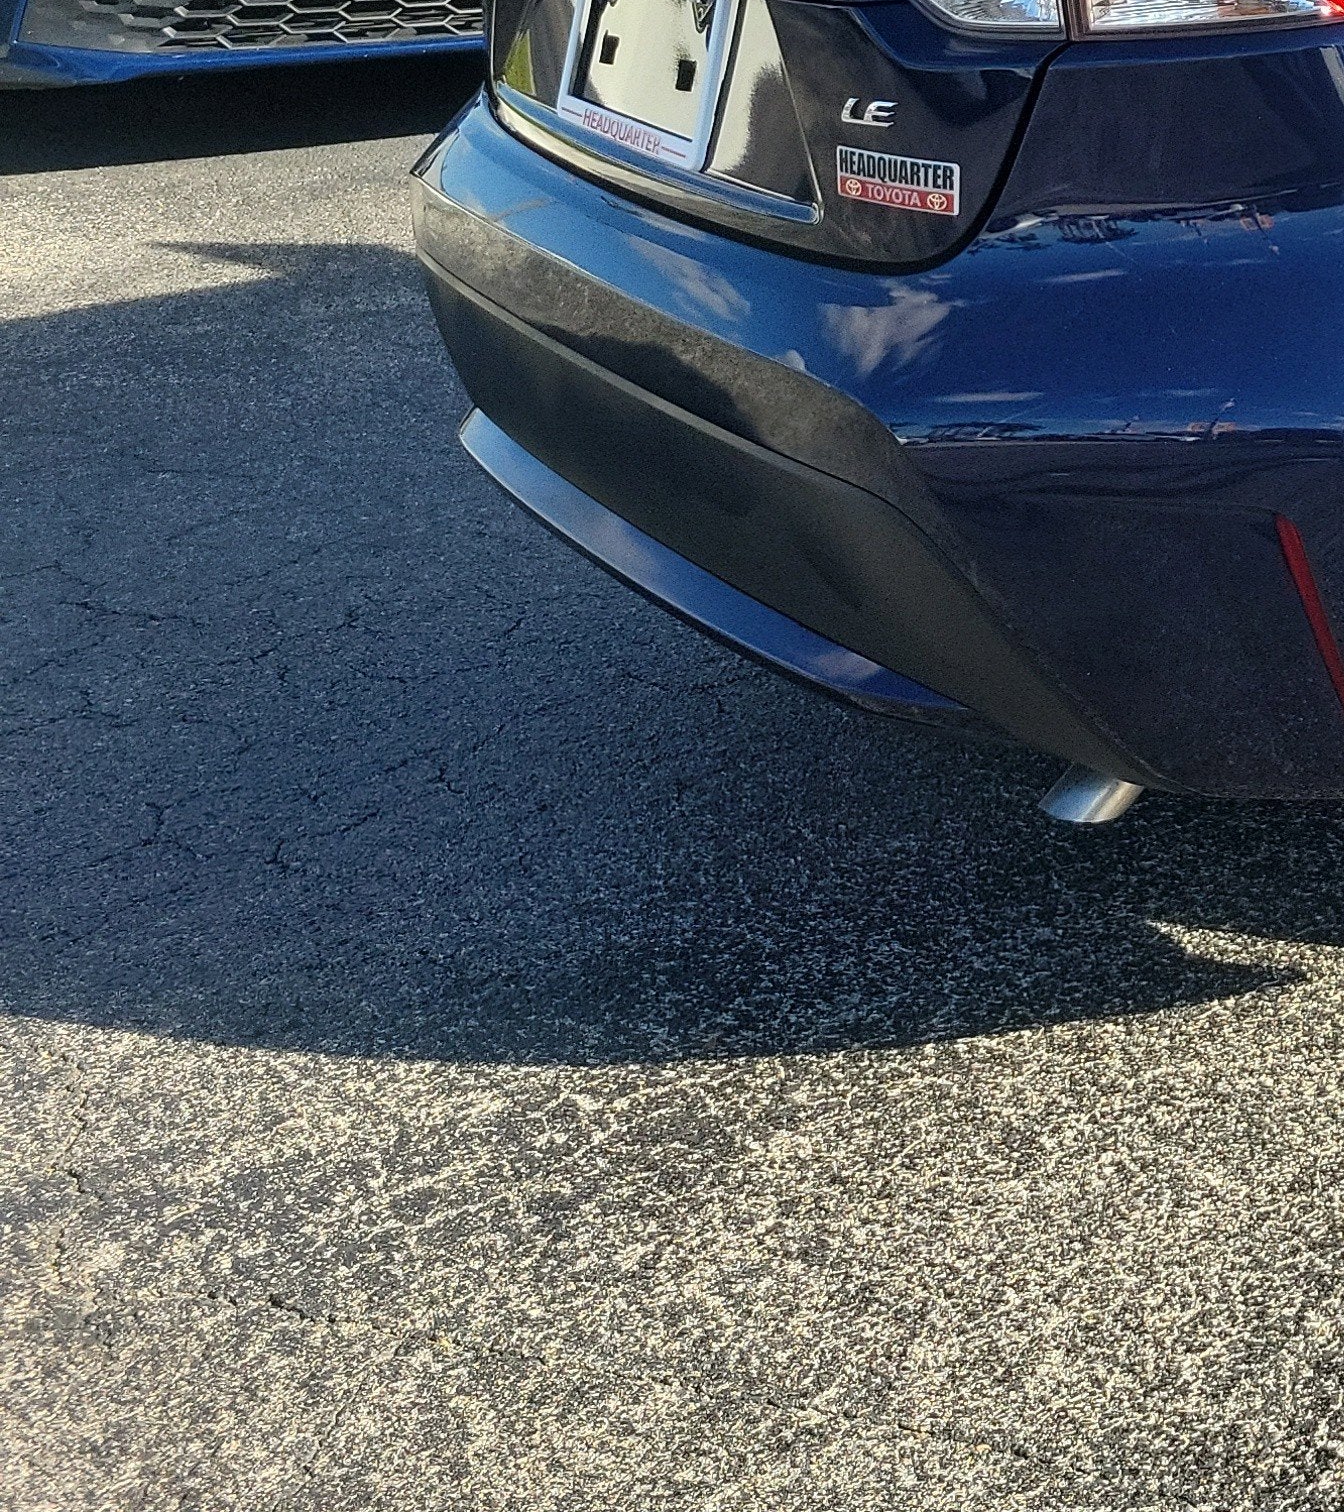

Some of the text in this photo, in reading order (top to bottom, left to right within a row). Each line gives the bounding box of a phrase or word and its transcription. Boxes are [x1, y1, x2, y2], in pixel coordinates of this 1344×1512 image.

[841, 97, 898, 127] LE
[583, 108, 660, 155] HEADQUARTER
[840, 148, 955, 191] HEADQUARTER
[864, 183, 922, 207] TOYOTA
